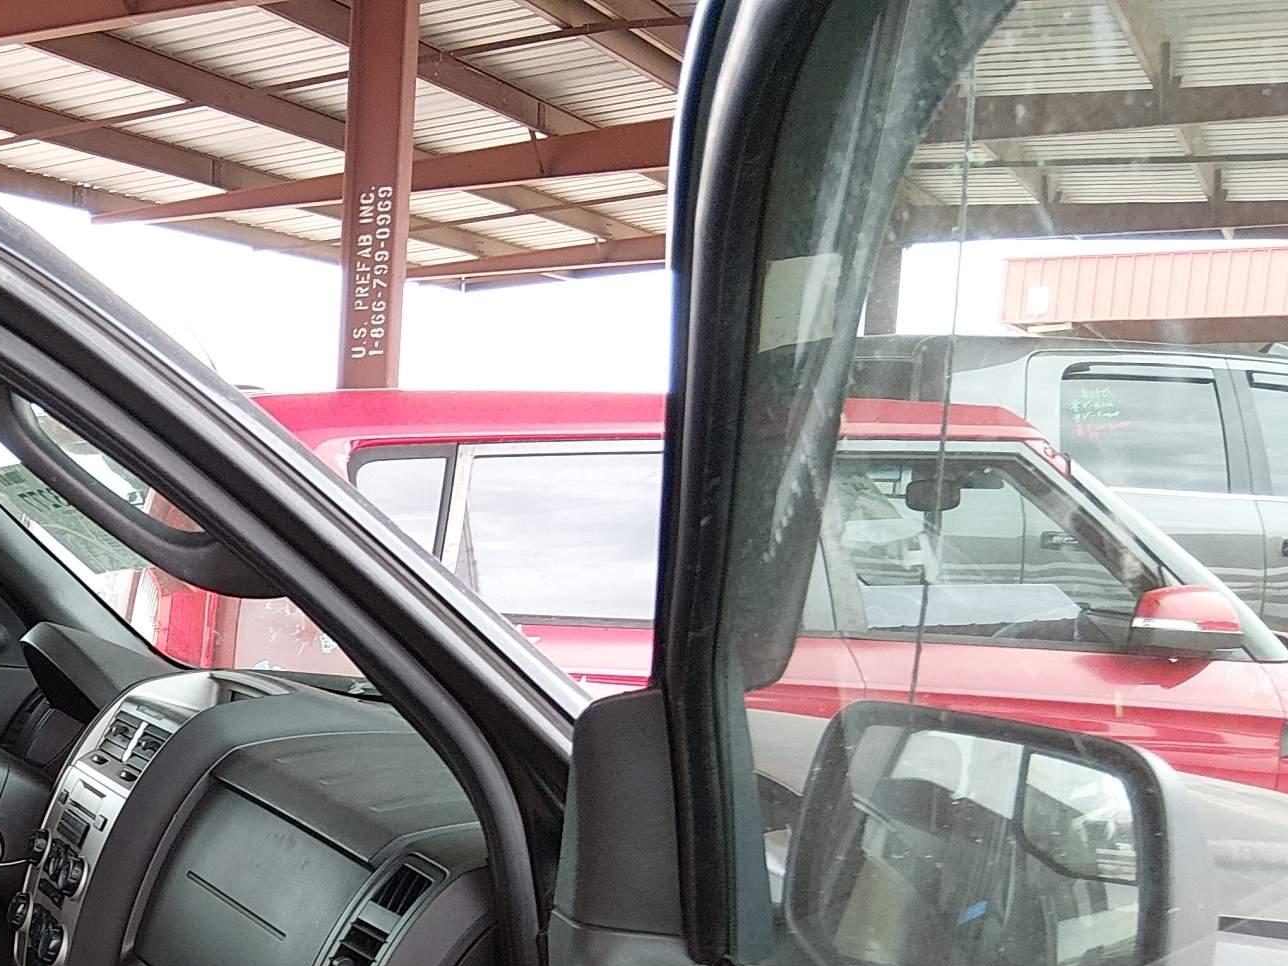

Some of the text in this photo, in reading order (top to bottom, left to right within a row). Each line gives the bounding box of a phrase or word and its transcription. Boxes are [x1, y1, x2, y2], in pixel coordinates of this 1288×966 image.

[351, 186, 375, 359] U.S. PREFAB INC.
[368, 186, 393, 357] 1-866-799-0969
